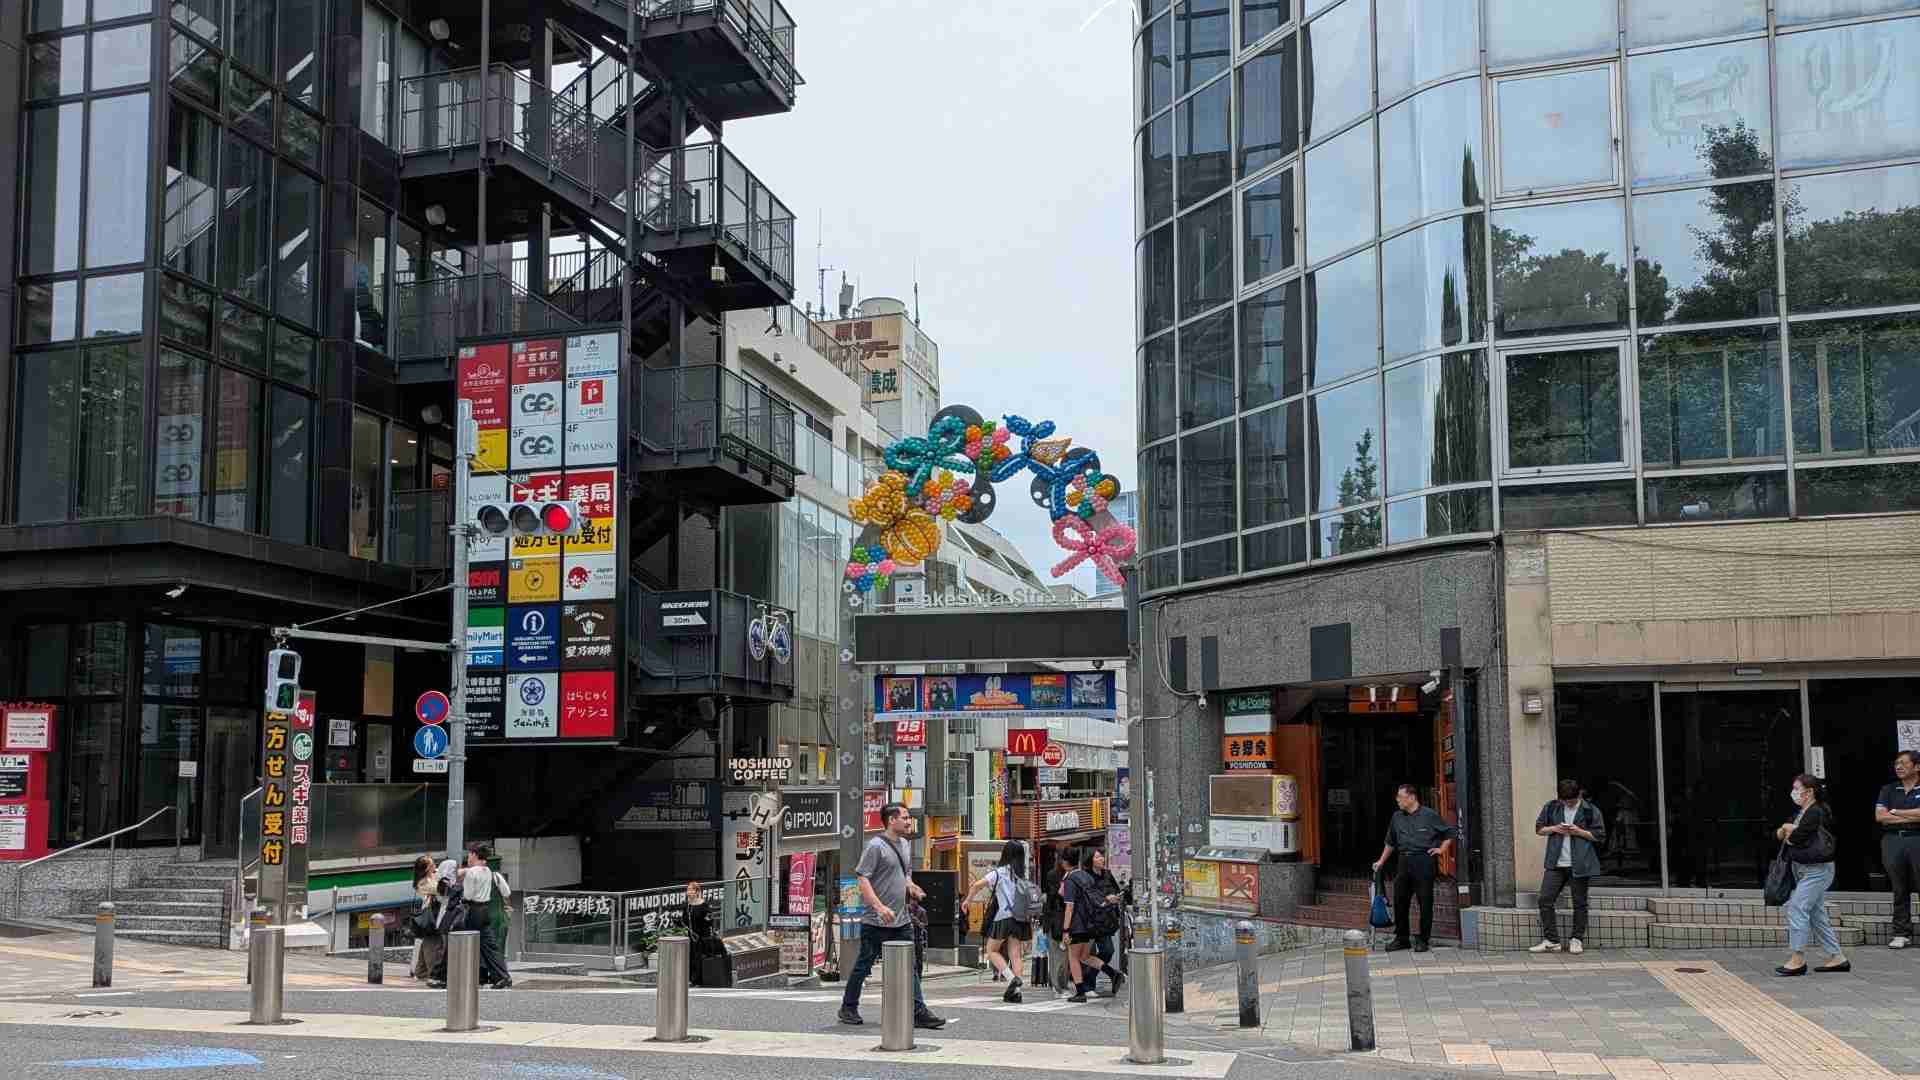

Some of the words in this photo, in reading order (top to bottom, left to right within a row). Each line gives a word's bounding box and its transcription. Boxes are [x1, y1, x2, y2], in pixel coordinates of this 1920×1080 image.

[1231, 739, 1266, 756] 吉野家
[728, 757, 793, 769] HOSHINO
[734, 769, 787, 780] COFFEE
[263, 712, 288, 865] 方せん受付
[290, 764, 311, 845] スギ薬局
[793, 810, 833, 829] IPPUDO
[524, 895, 611, 915] 星乃珈琲店
[629, 894, 660, 910] HAND
